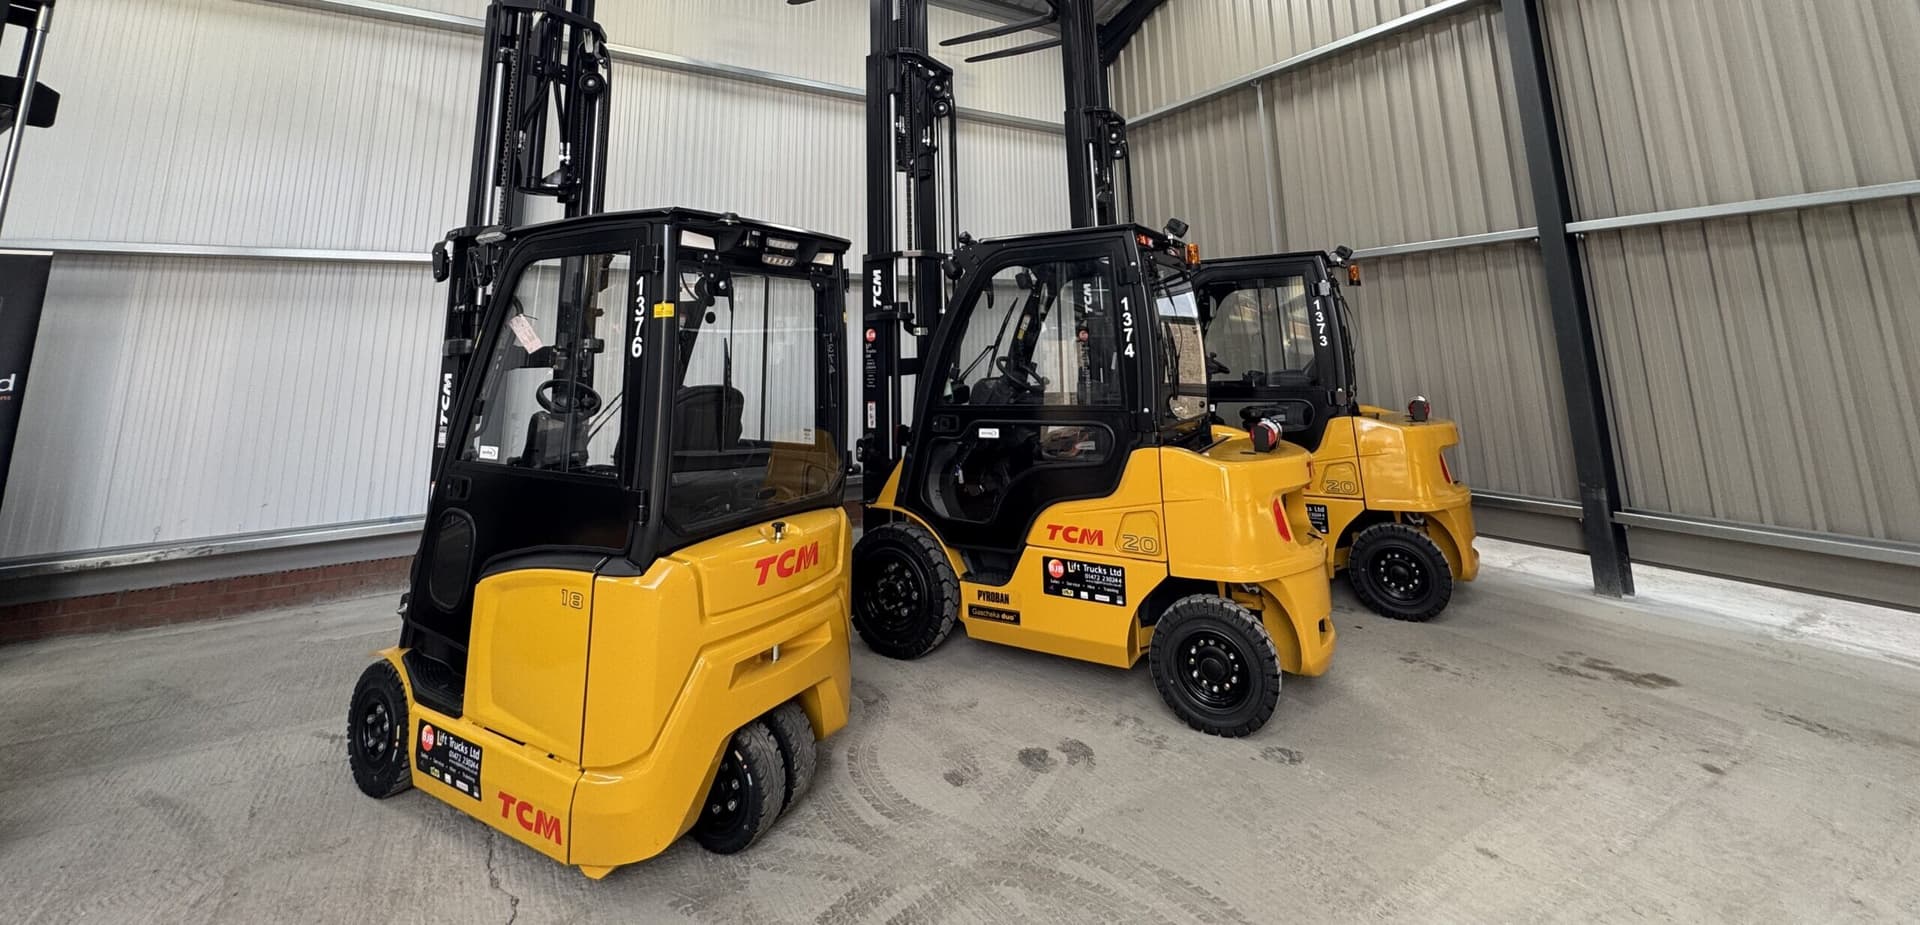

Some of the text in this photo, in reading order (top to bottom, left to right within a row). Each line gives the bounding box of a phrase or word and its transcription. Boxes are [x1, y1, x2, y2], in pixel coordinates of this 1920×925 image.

[873, 269, 882, 308] TCM
[1083, 283, 1093, 314] TCM
[631, 275, 645, 358] 1376
[1120, 296, 1135, 358] 1374
[1313, 299, 1328, 346] 1373
[440, 372, 453, 426] TCM
[1326, 480, 1355, 494] 20
[1046, 524, 1103, 546] TCM
[1122, 534, 1157, 554] 20
[755, 541, 819, 586] TCM
[1067, 561, 1122, 577] Lift Trucks Ltd
[561, 589, 584, 609] 18
[977, 589, 1010, 605] PYROBAN
[436, 730, 480, 760] Lift Trucks Ltd
[498, 790, 562, 846] TCM
